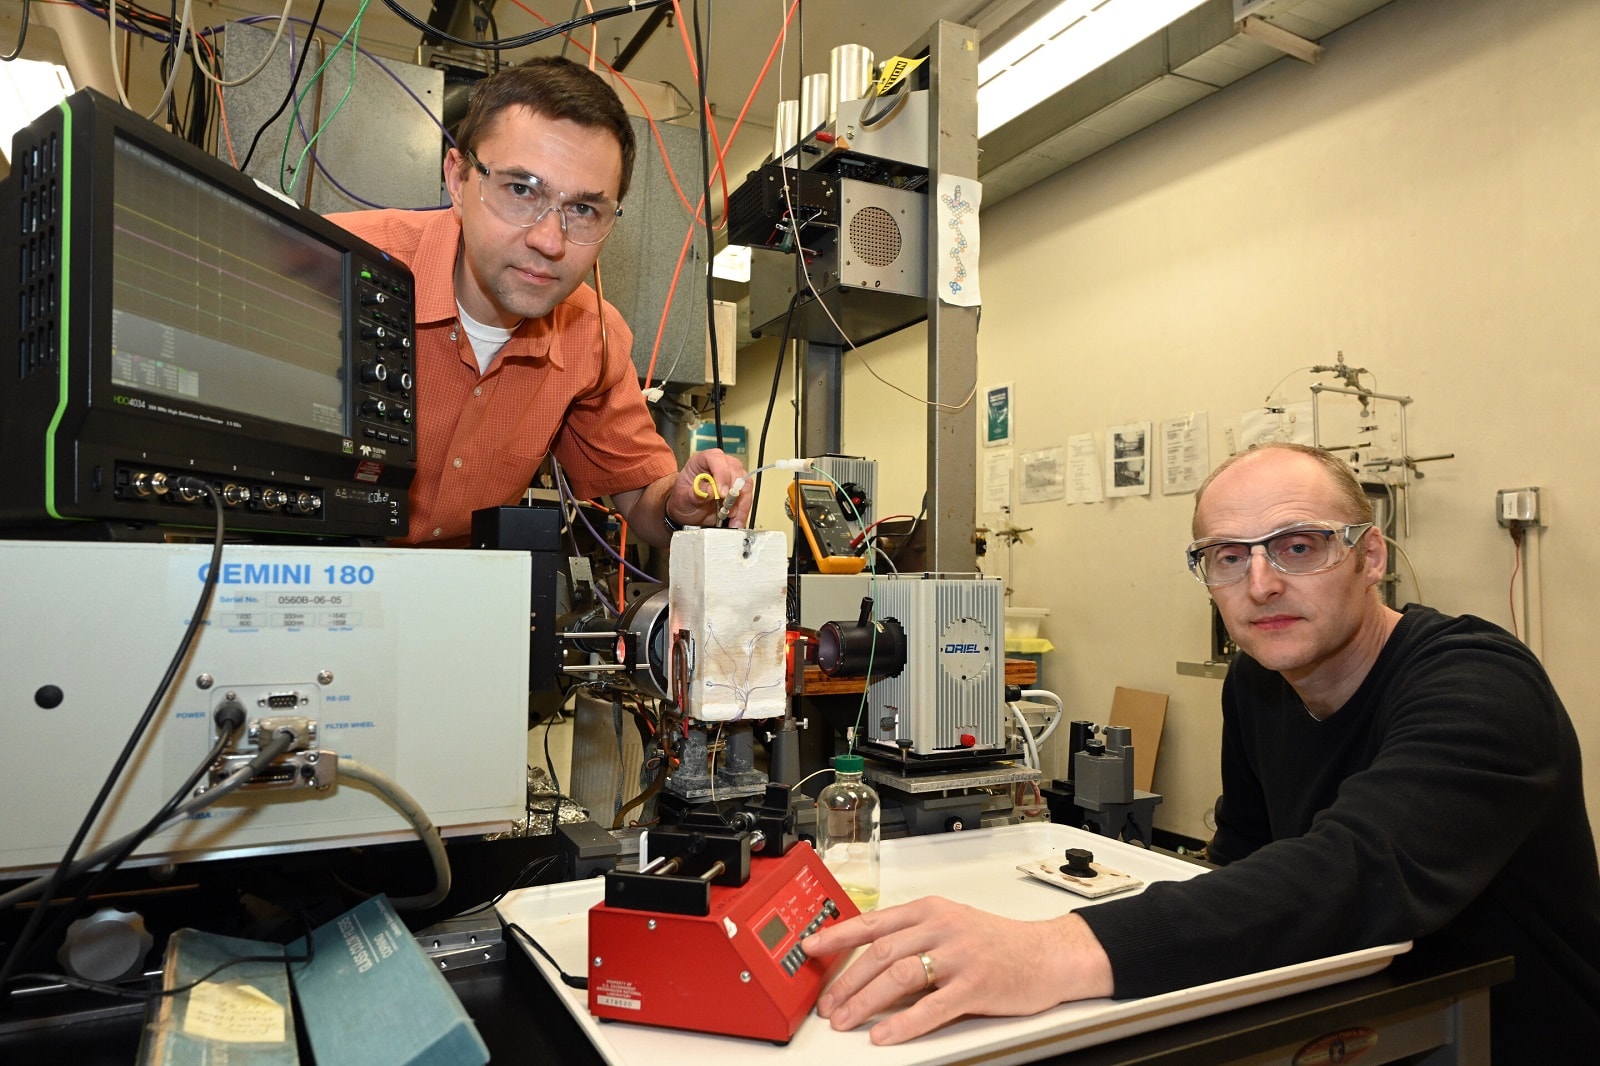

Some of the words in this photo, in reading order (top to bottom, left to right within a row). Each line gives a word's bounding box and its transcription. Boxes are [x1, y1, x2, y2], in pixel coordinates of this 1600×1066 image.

[113, 395, 145, 409] HDO4034
[198, 563, 311, 585] GEMINI
[324, 565, 375, 585] 180
[278, 596, 342, 605] 0560B-06-05
[945, 644, 980, 653] ORIEL
[176, 711, 206, 719] POWER
[353, 950, 373, 973] GLASS
